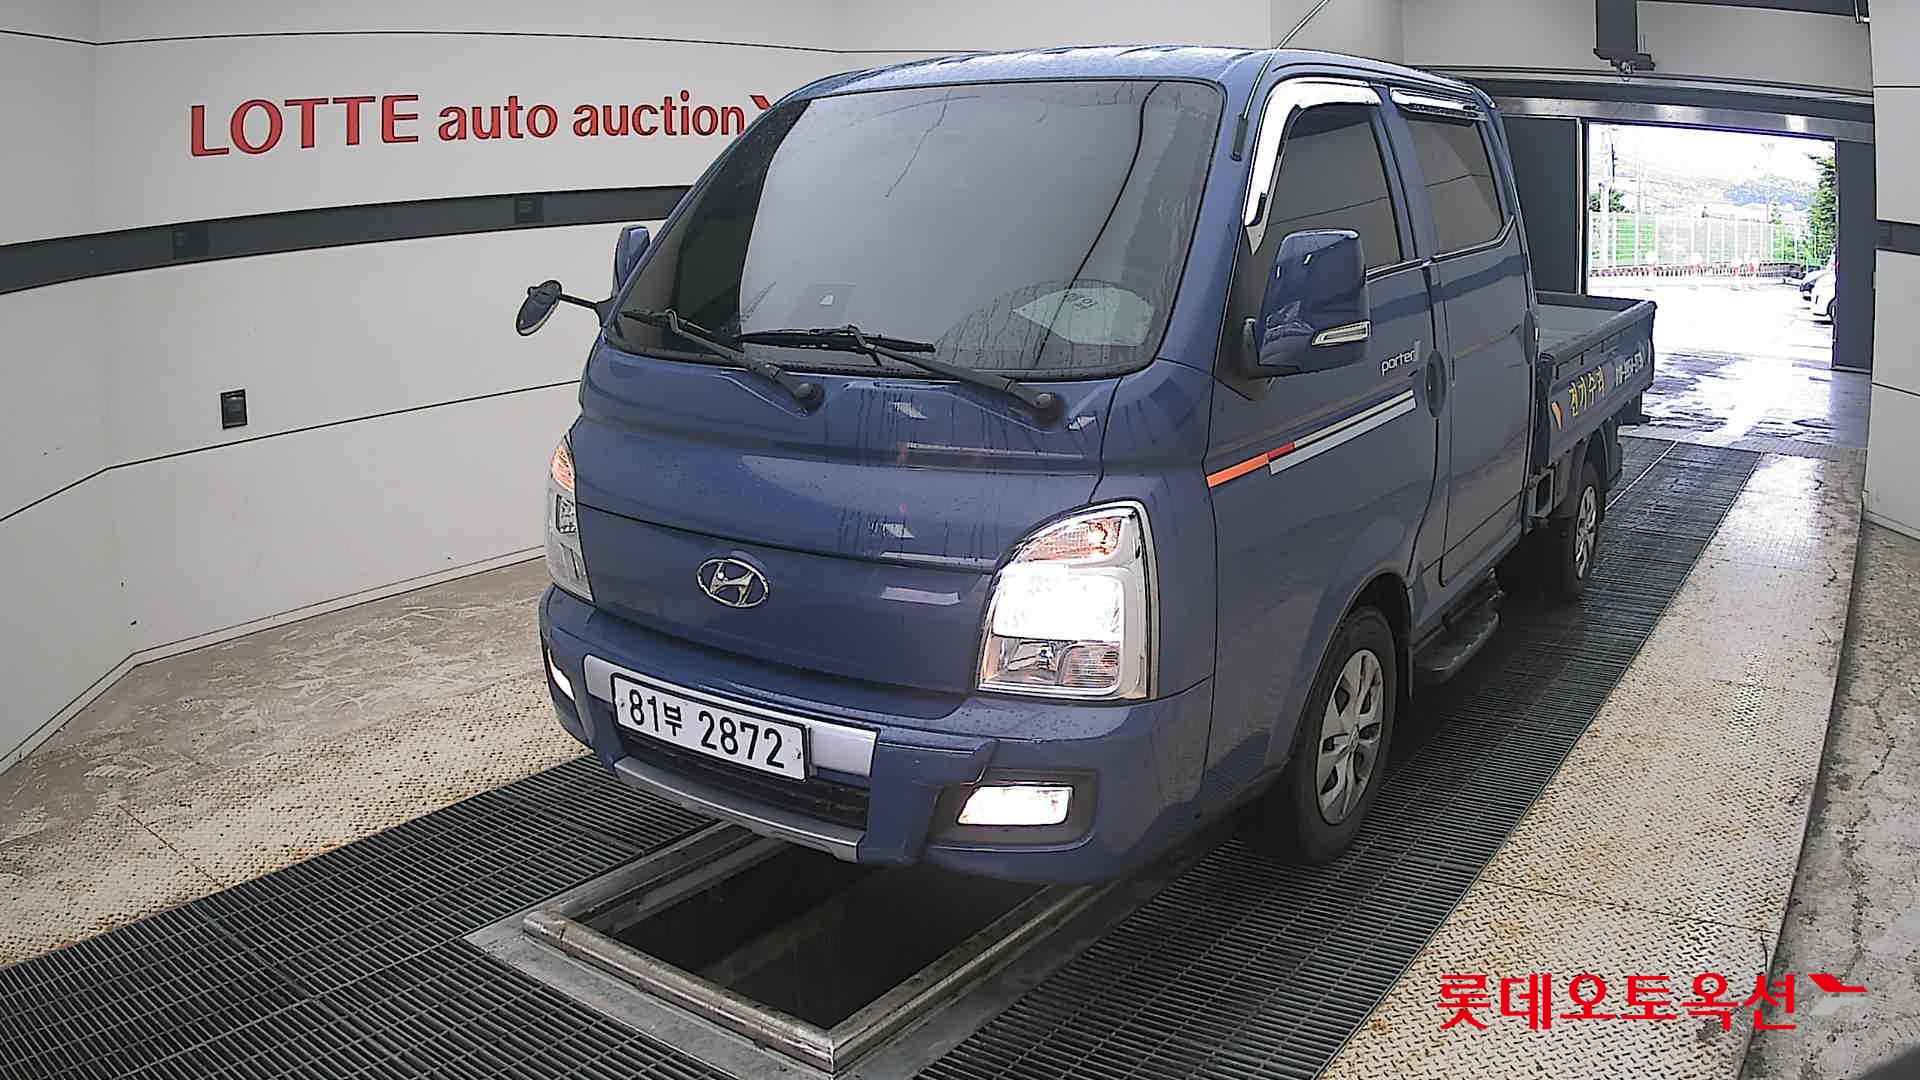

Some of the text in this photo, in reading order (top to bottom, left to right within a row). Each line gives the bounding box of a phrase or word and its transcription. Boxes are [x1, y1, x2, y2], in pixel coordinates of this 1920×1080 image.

[191, 90, 745, 157] LOTTE auto auction
[628, 688, 785, 769] 81부 2872
